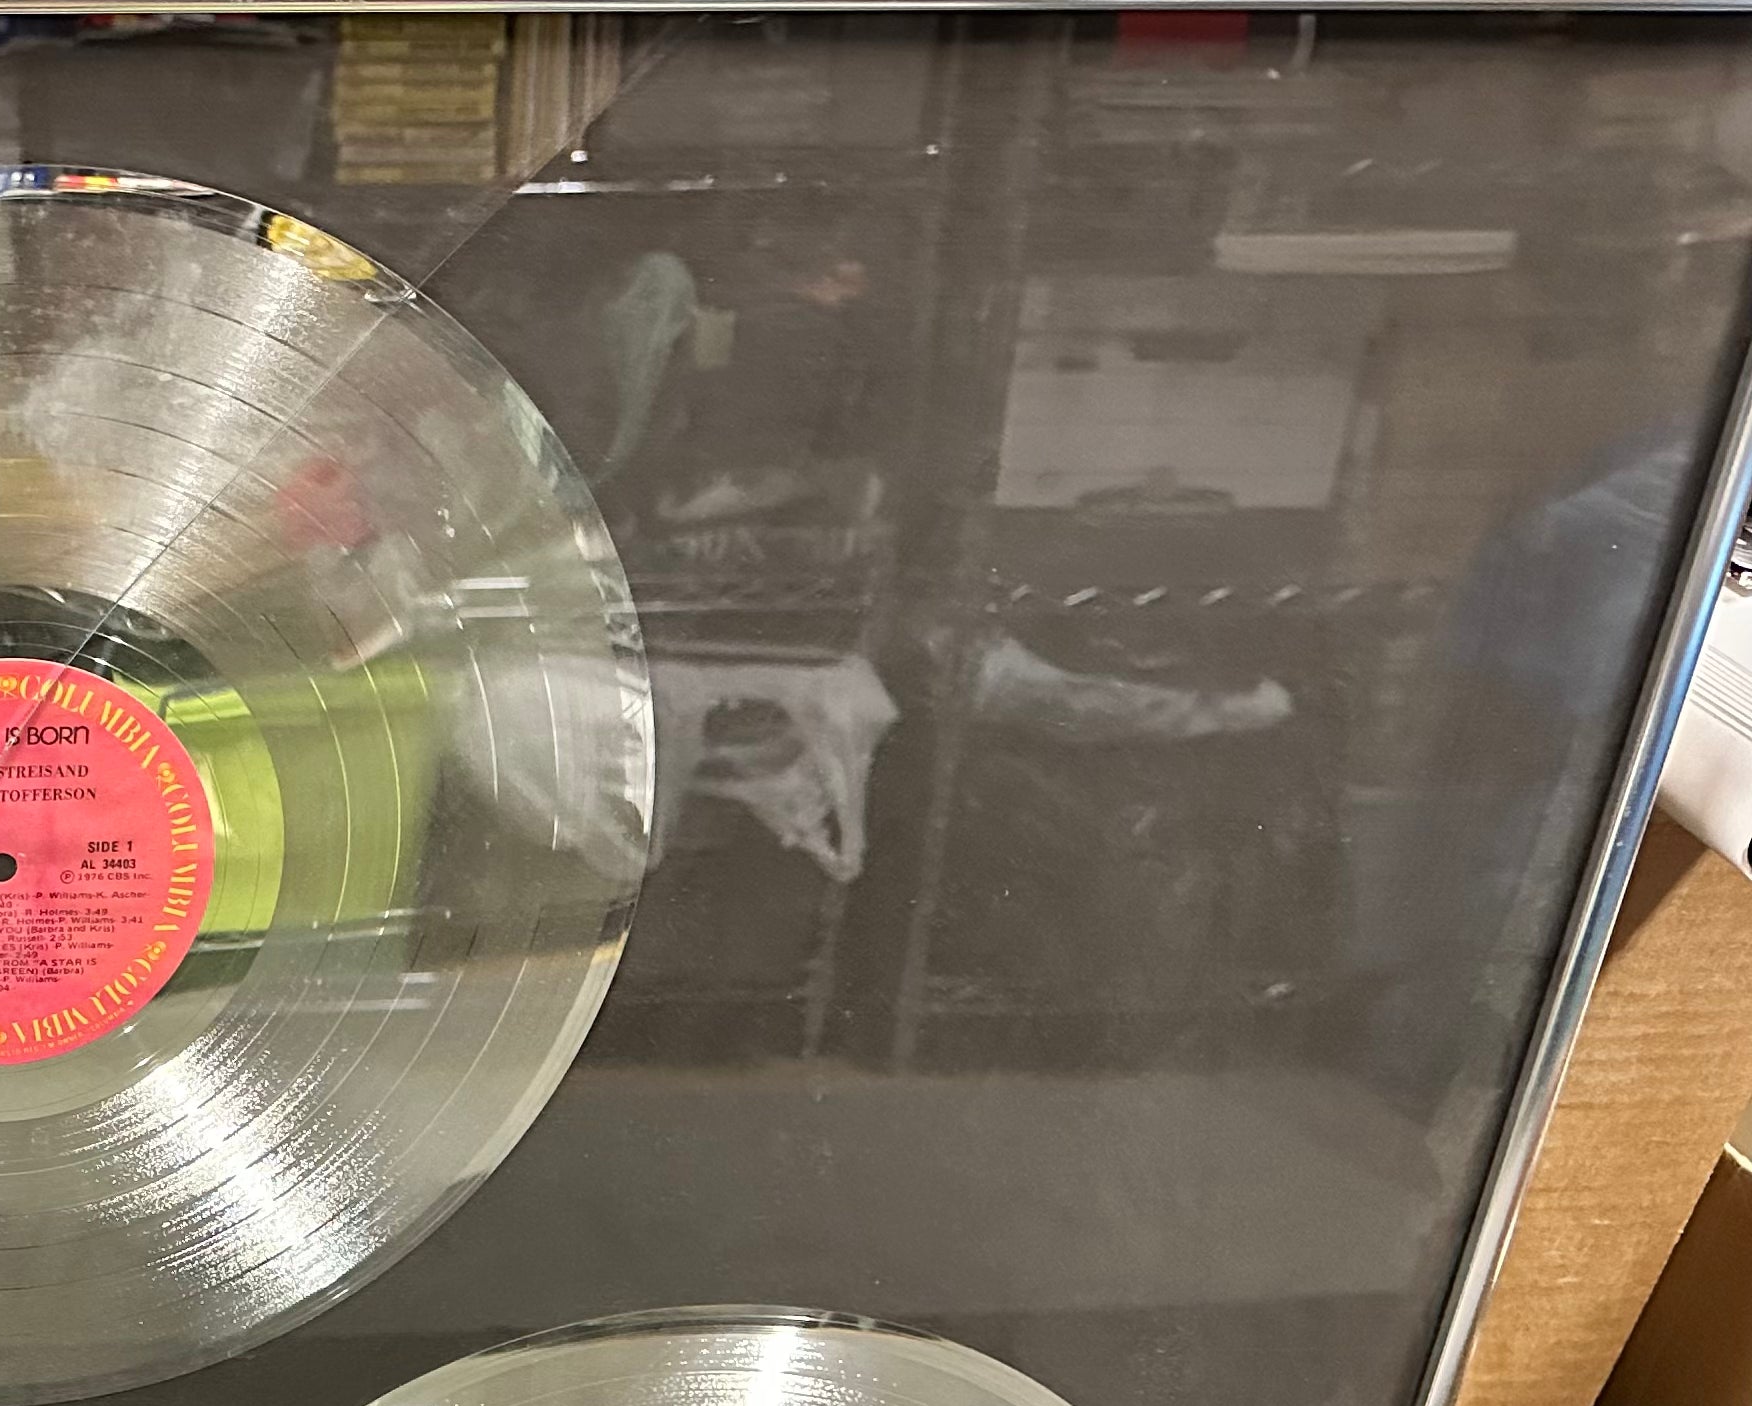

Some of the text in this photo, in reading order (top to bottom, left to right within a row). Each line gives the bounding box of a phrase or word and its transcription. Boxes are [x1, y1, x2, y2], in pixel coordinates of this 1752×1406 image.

[19, 673, 163, 769] COLUMBIA
[5, 727, 20, 748] IS
[27, 725, 90, 746] BORN
[87, 840, 134, 854] SIDE 1
[165, 782, 199, 934] COLUMBIA
[80, 858, 136, 871] AL 34403
[50, 958, 83, 967] STAR
[87, 957, 98, 966] IS
[12, 957, 154, 1044] COLUMBIA
